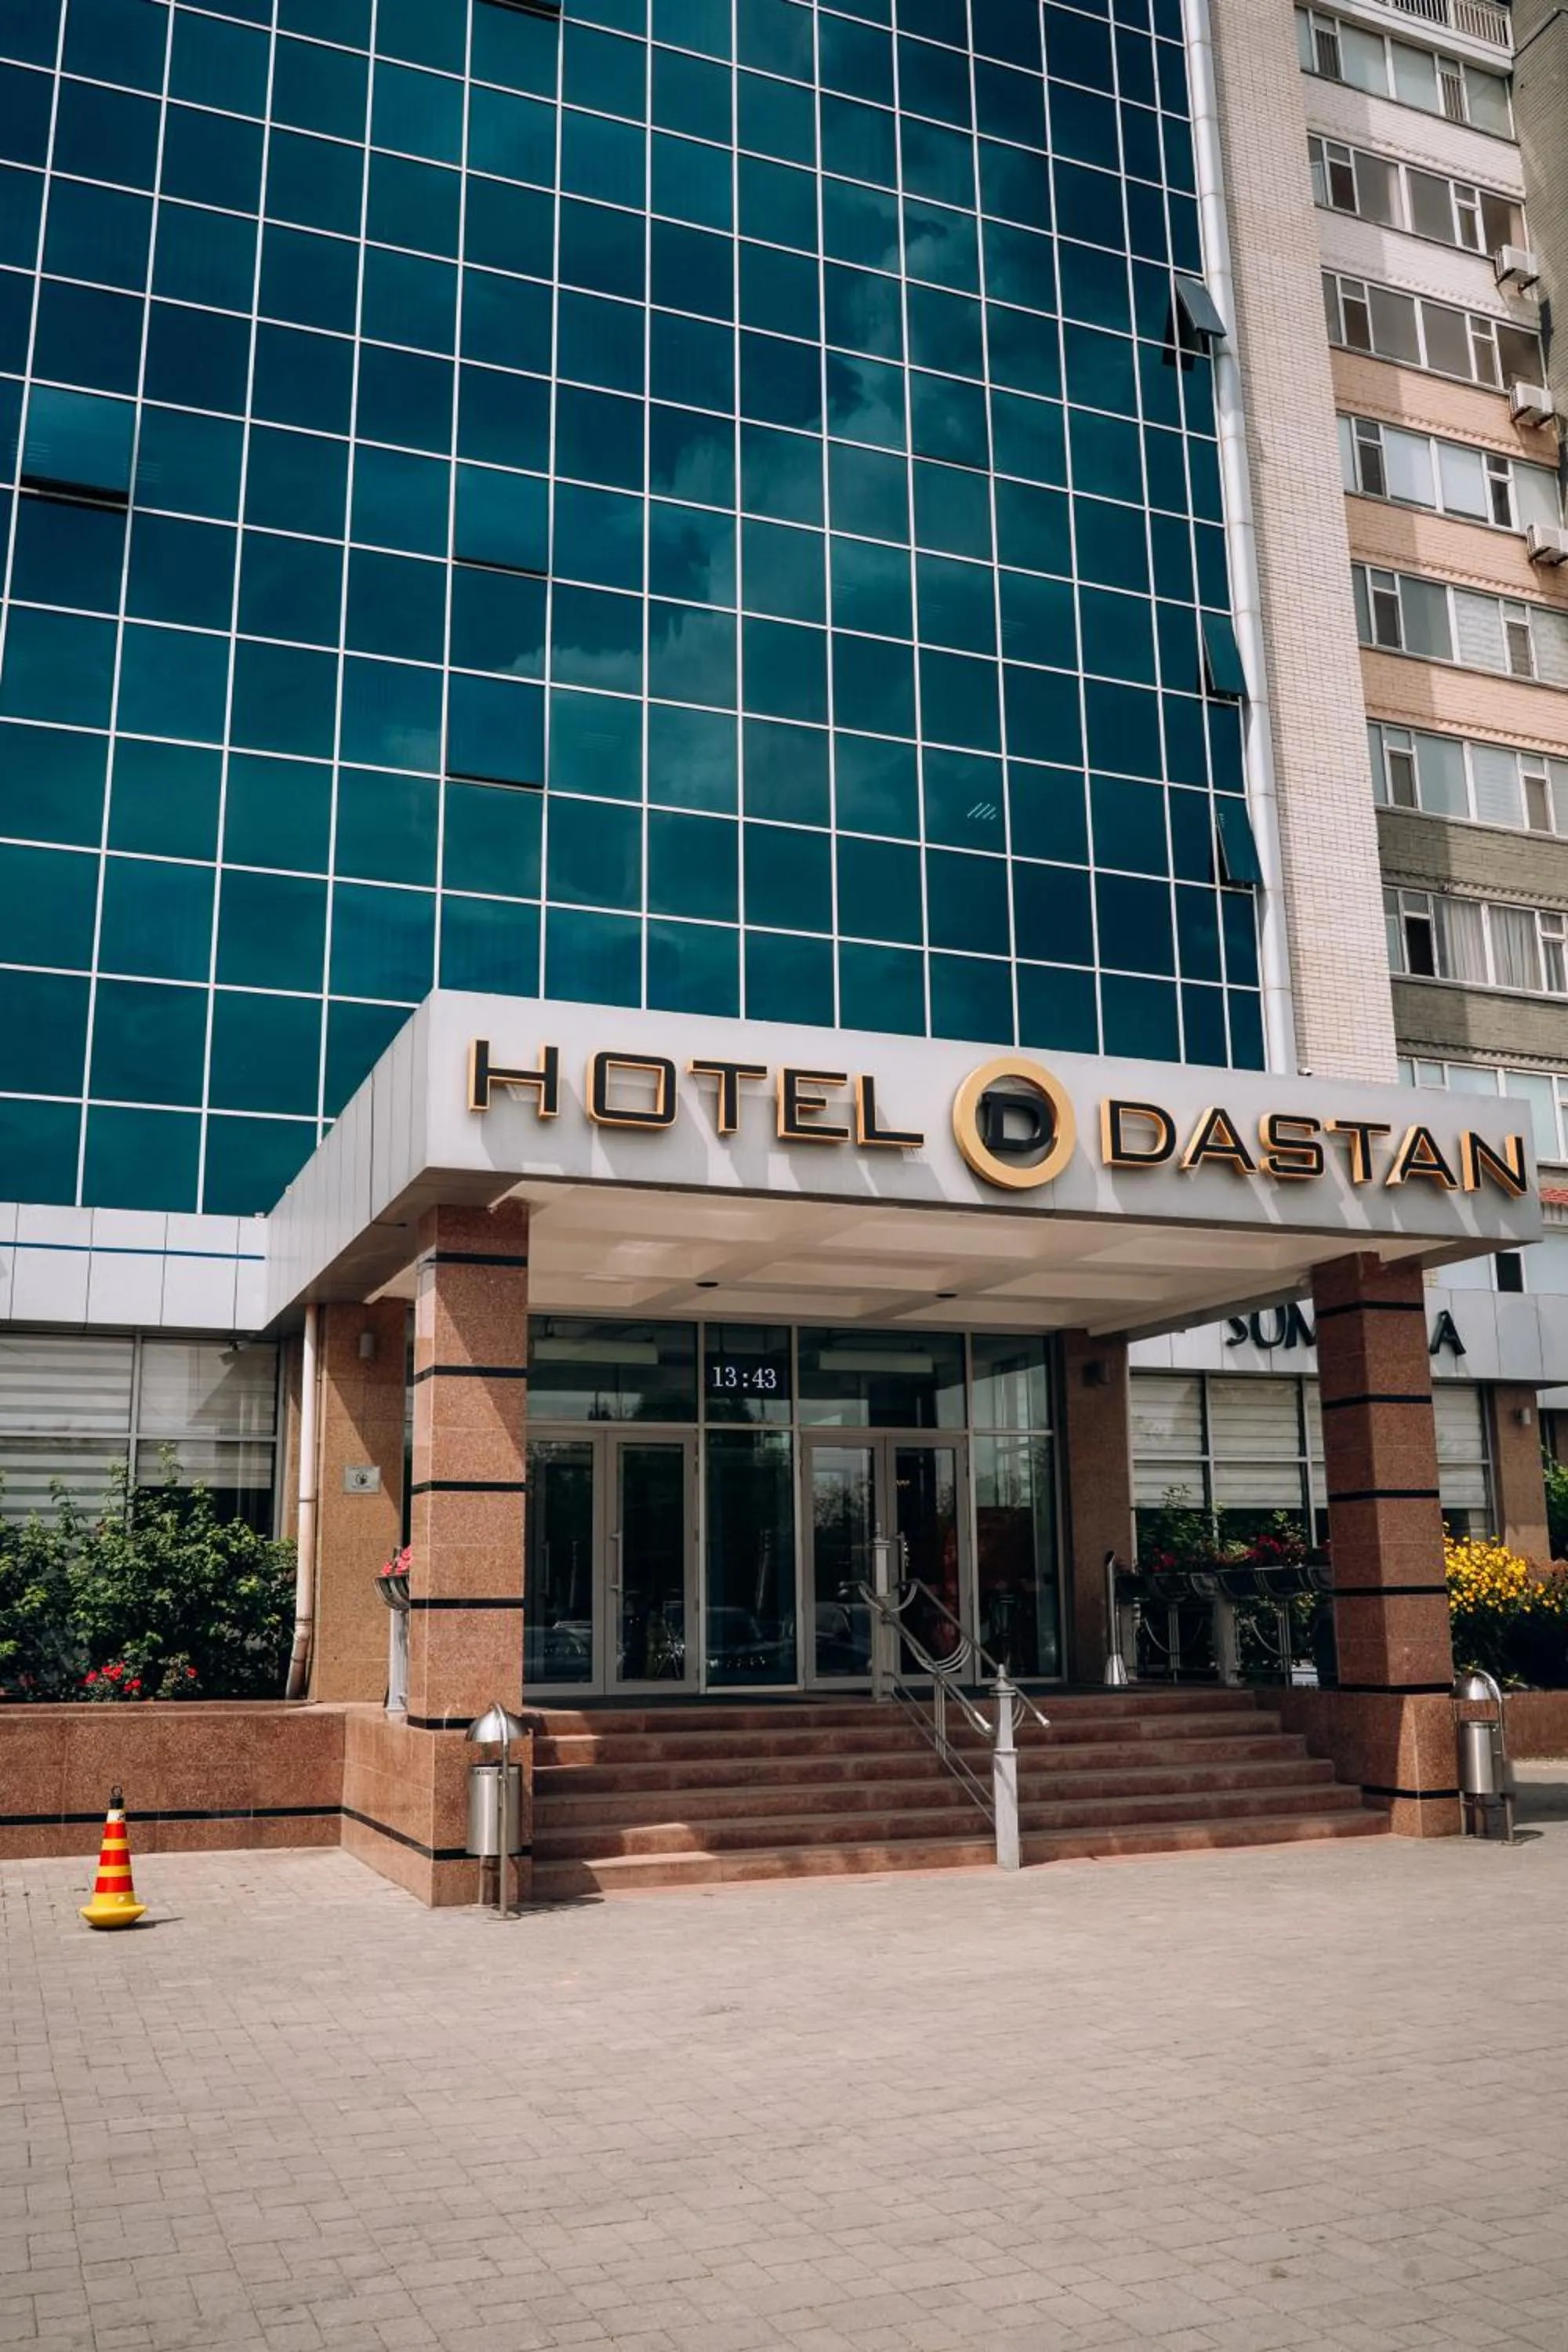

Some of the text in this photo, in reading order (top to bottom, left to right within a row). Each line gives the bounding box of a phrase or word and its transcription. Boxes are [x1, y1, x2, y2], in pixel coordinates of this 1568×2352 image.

[470, 1039, 1528, 1197] HOTEL DASTAN
[982, 1091, 1053, 1152] D
[713, 1367, 777, 1388] 13:43
